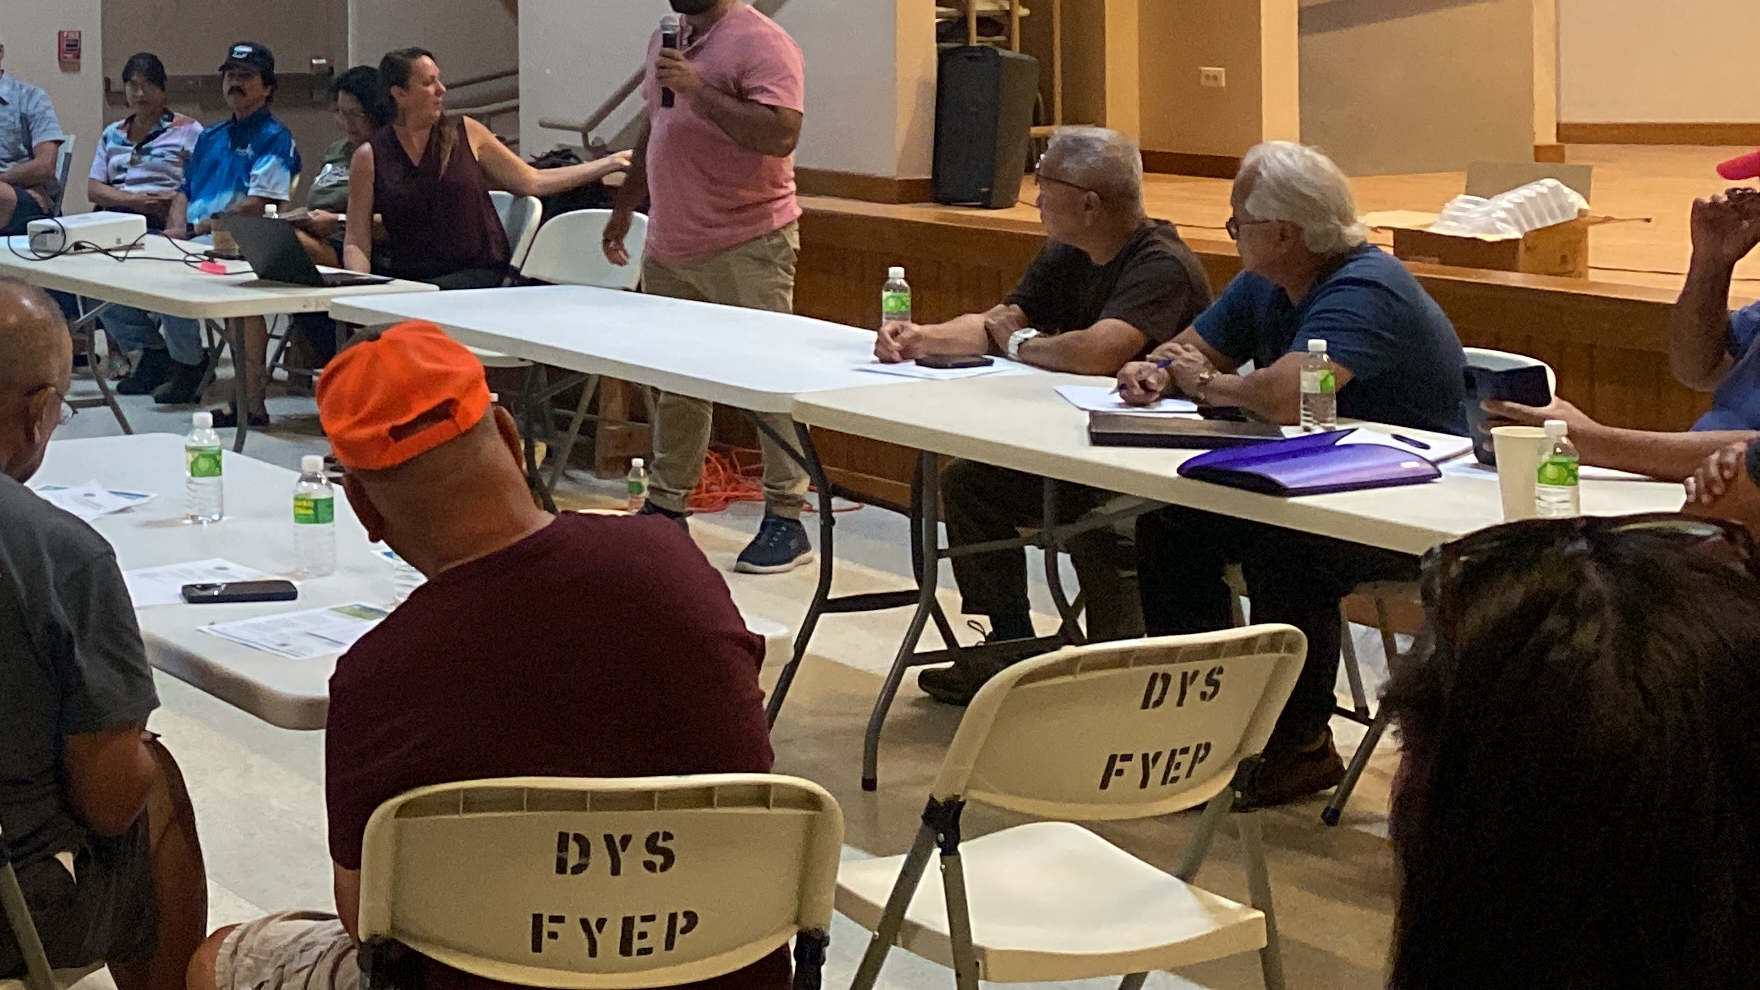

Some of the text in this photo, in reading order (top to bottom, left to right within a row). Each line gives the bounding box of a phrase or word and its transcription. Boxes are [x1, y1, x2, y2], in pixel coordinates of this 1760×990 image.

[1140, 666, 1224, 710] DYS
[1099, 741, 1212, 790] FYEP
[555, 830, 675, 877] DYS
[531, 910, 698, 958] FYEP
